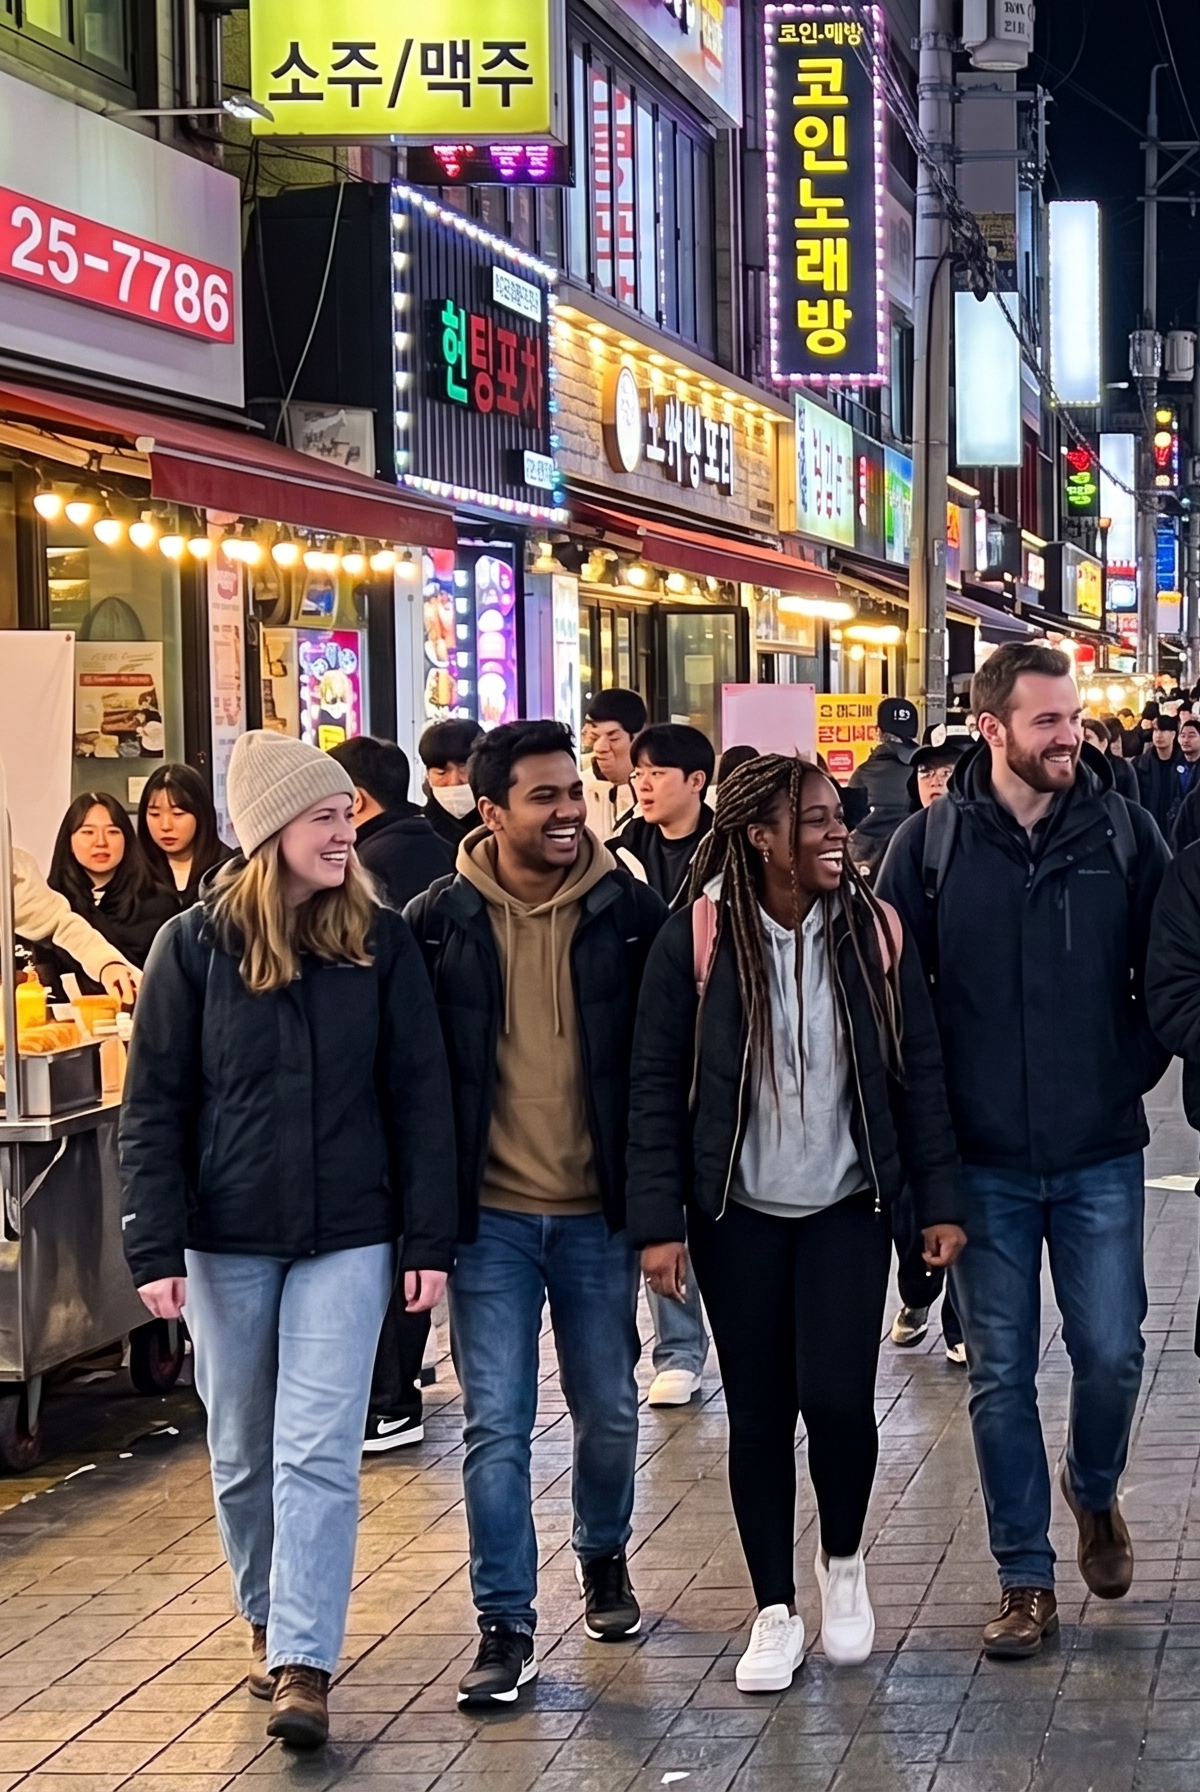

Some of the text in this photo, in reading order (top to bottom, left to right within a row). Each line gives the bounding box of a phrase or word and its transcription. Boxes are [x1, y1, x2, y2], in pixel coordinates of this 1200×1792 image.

[268, 38, 534, 109] 소주/맥주
[11, 205, 229, 332] 25-7786
[792, 57, 852, 356] 코인노래방
[441, 299, 543, 429] 헌팅포차
